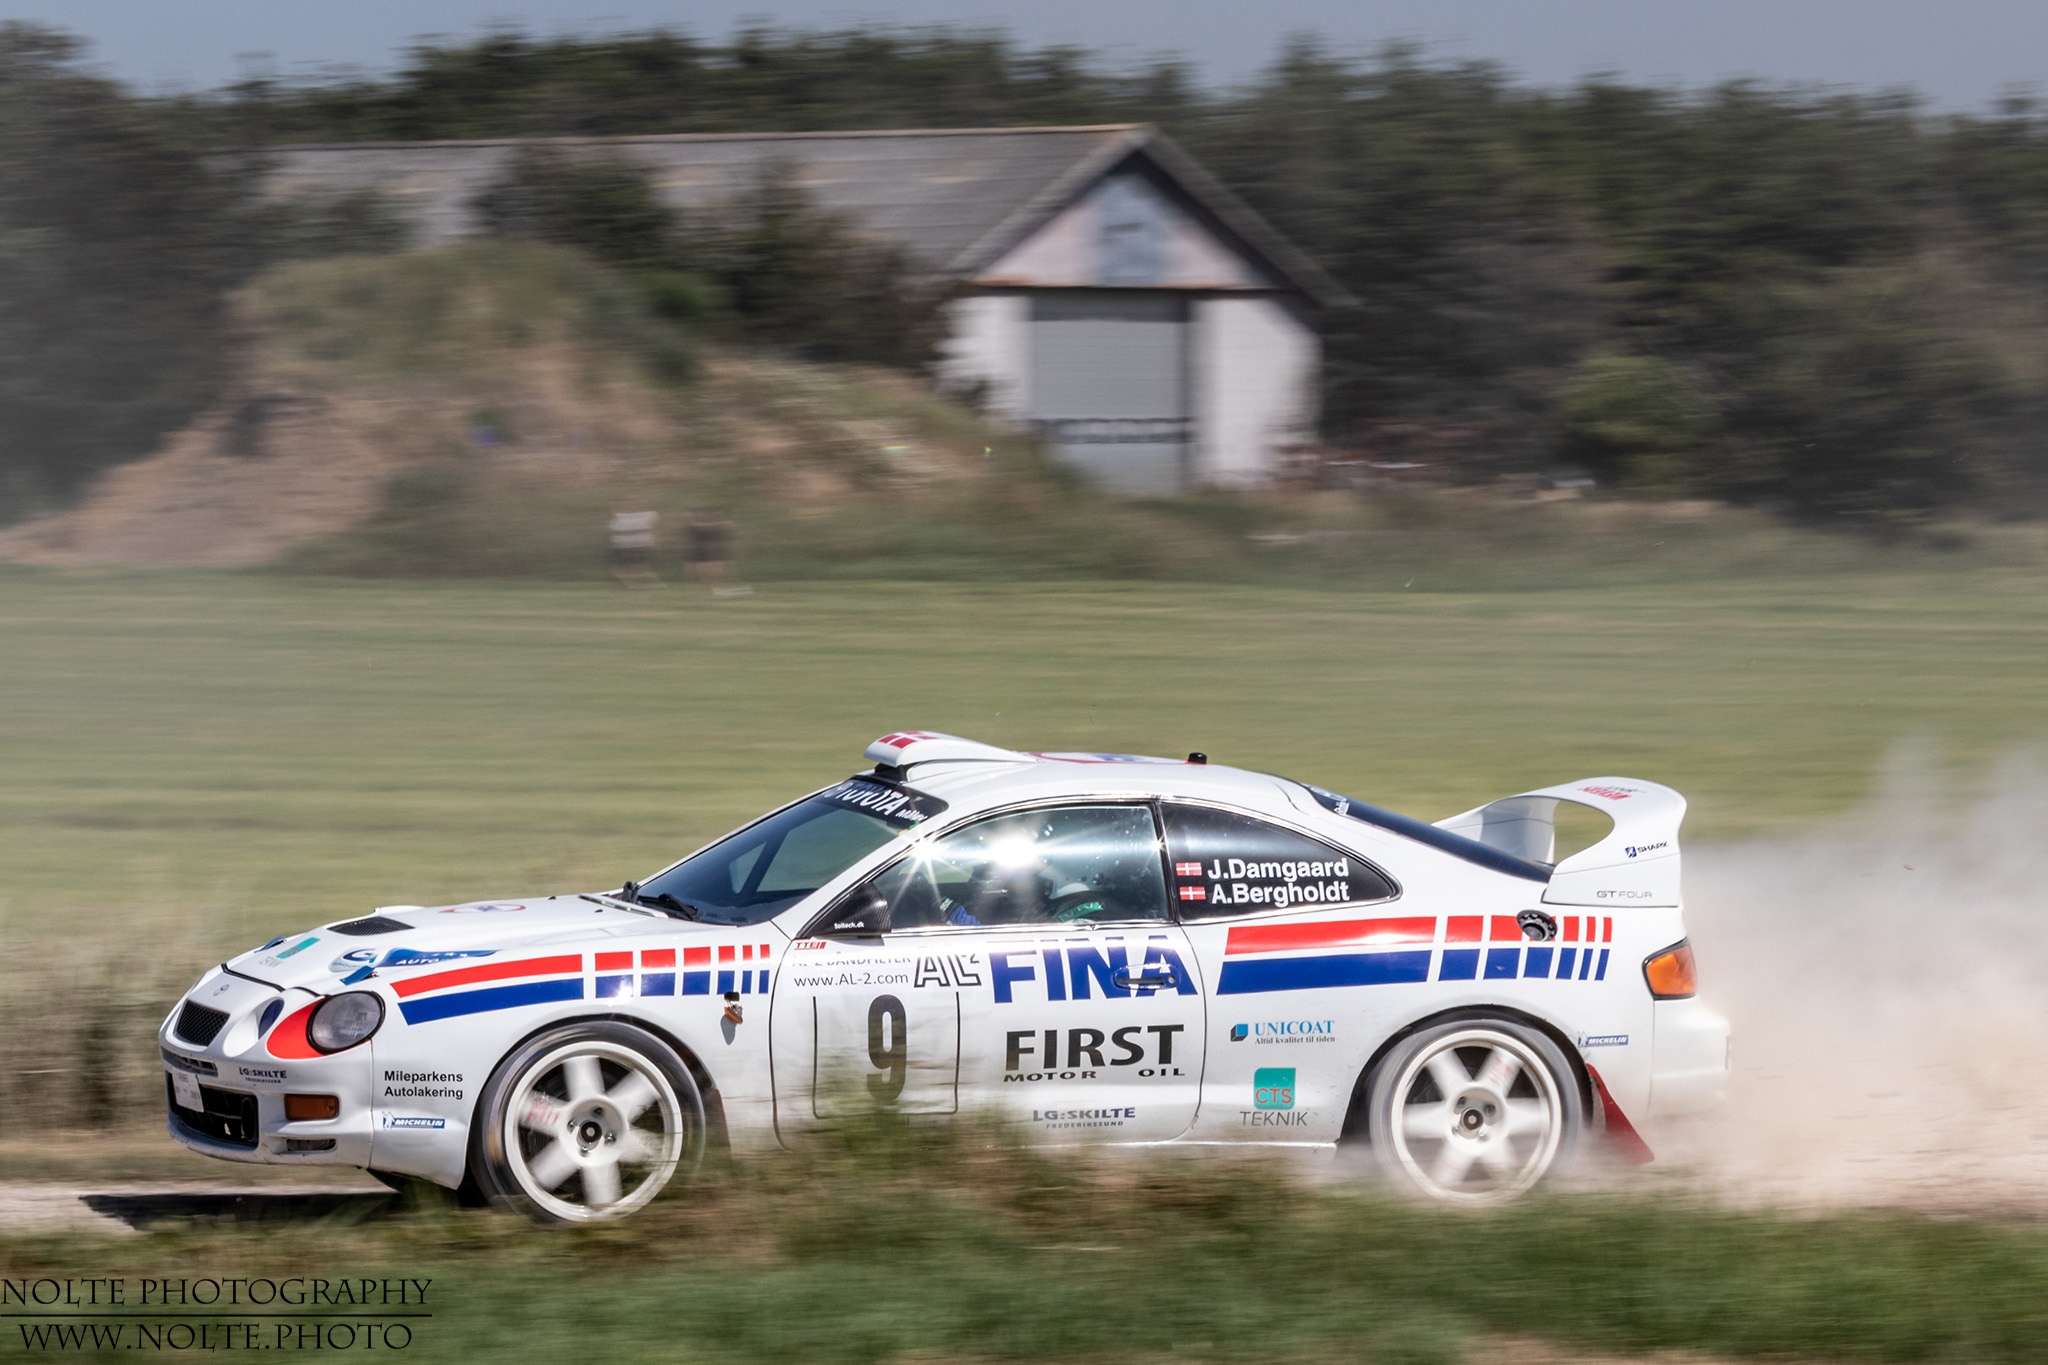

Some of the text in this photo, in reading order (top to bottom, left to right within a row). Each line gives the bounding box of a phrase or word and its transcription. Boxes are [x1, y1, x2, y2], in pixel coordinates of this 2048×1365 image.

[1207, 857, 1350, 883] J.Damgaard
[1211, 880, 1351, 908] A.Bergholdt
[1596, 890, 1653, 899] GT FOUR
[986, 934, 1199, 1004] FINA
[793, 972, 909, 987] www.AL-2.com
[1254, 1019, 1336, 1036] UNICOAT
[866, 993, 907, 1101] 9
[1005, 1023, 1185, 1071] FIRST
[1254, 1035, 1336, 1045] Altid kvalitet til tiden
[1588, 1036, 1628, 1045] MICHELIN
[384, 1070, 464, 1084] Mileparkens
[1003, 1067, 1186, 1083] MOTOR OIL
[384, 1085, 464, 1101] Autolakering
[1255, 1087, 1293, 1104] CTS
[394, 1118, 444, 1127] MICHELIN
[1046, 1120, 1124, 1129] FREDERIKSSUND
[1239, 1111, 1309, 1127] TEKNIK
